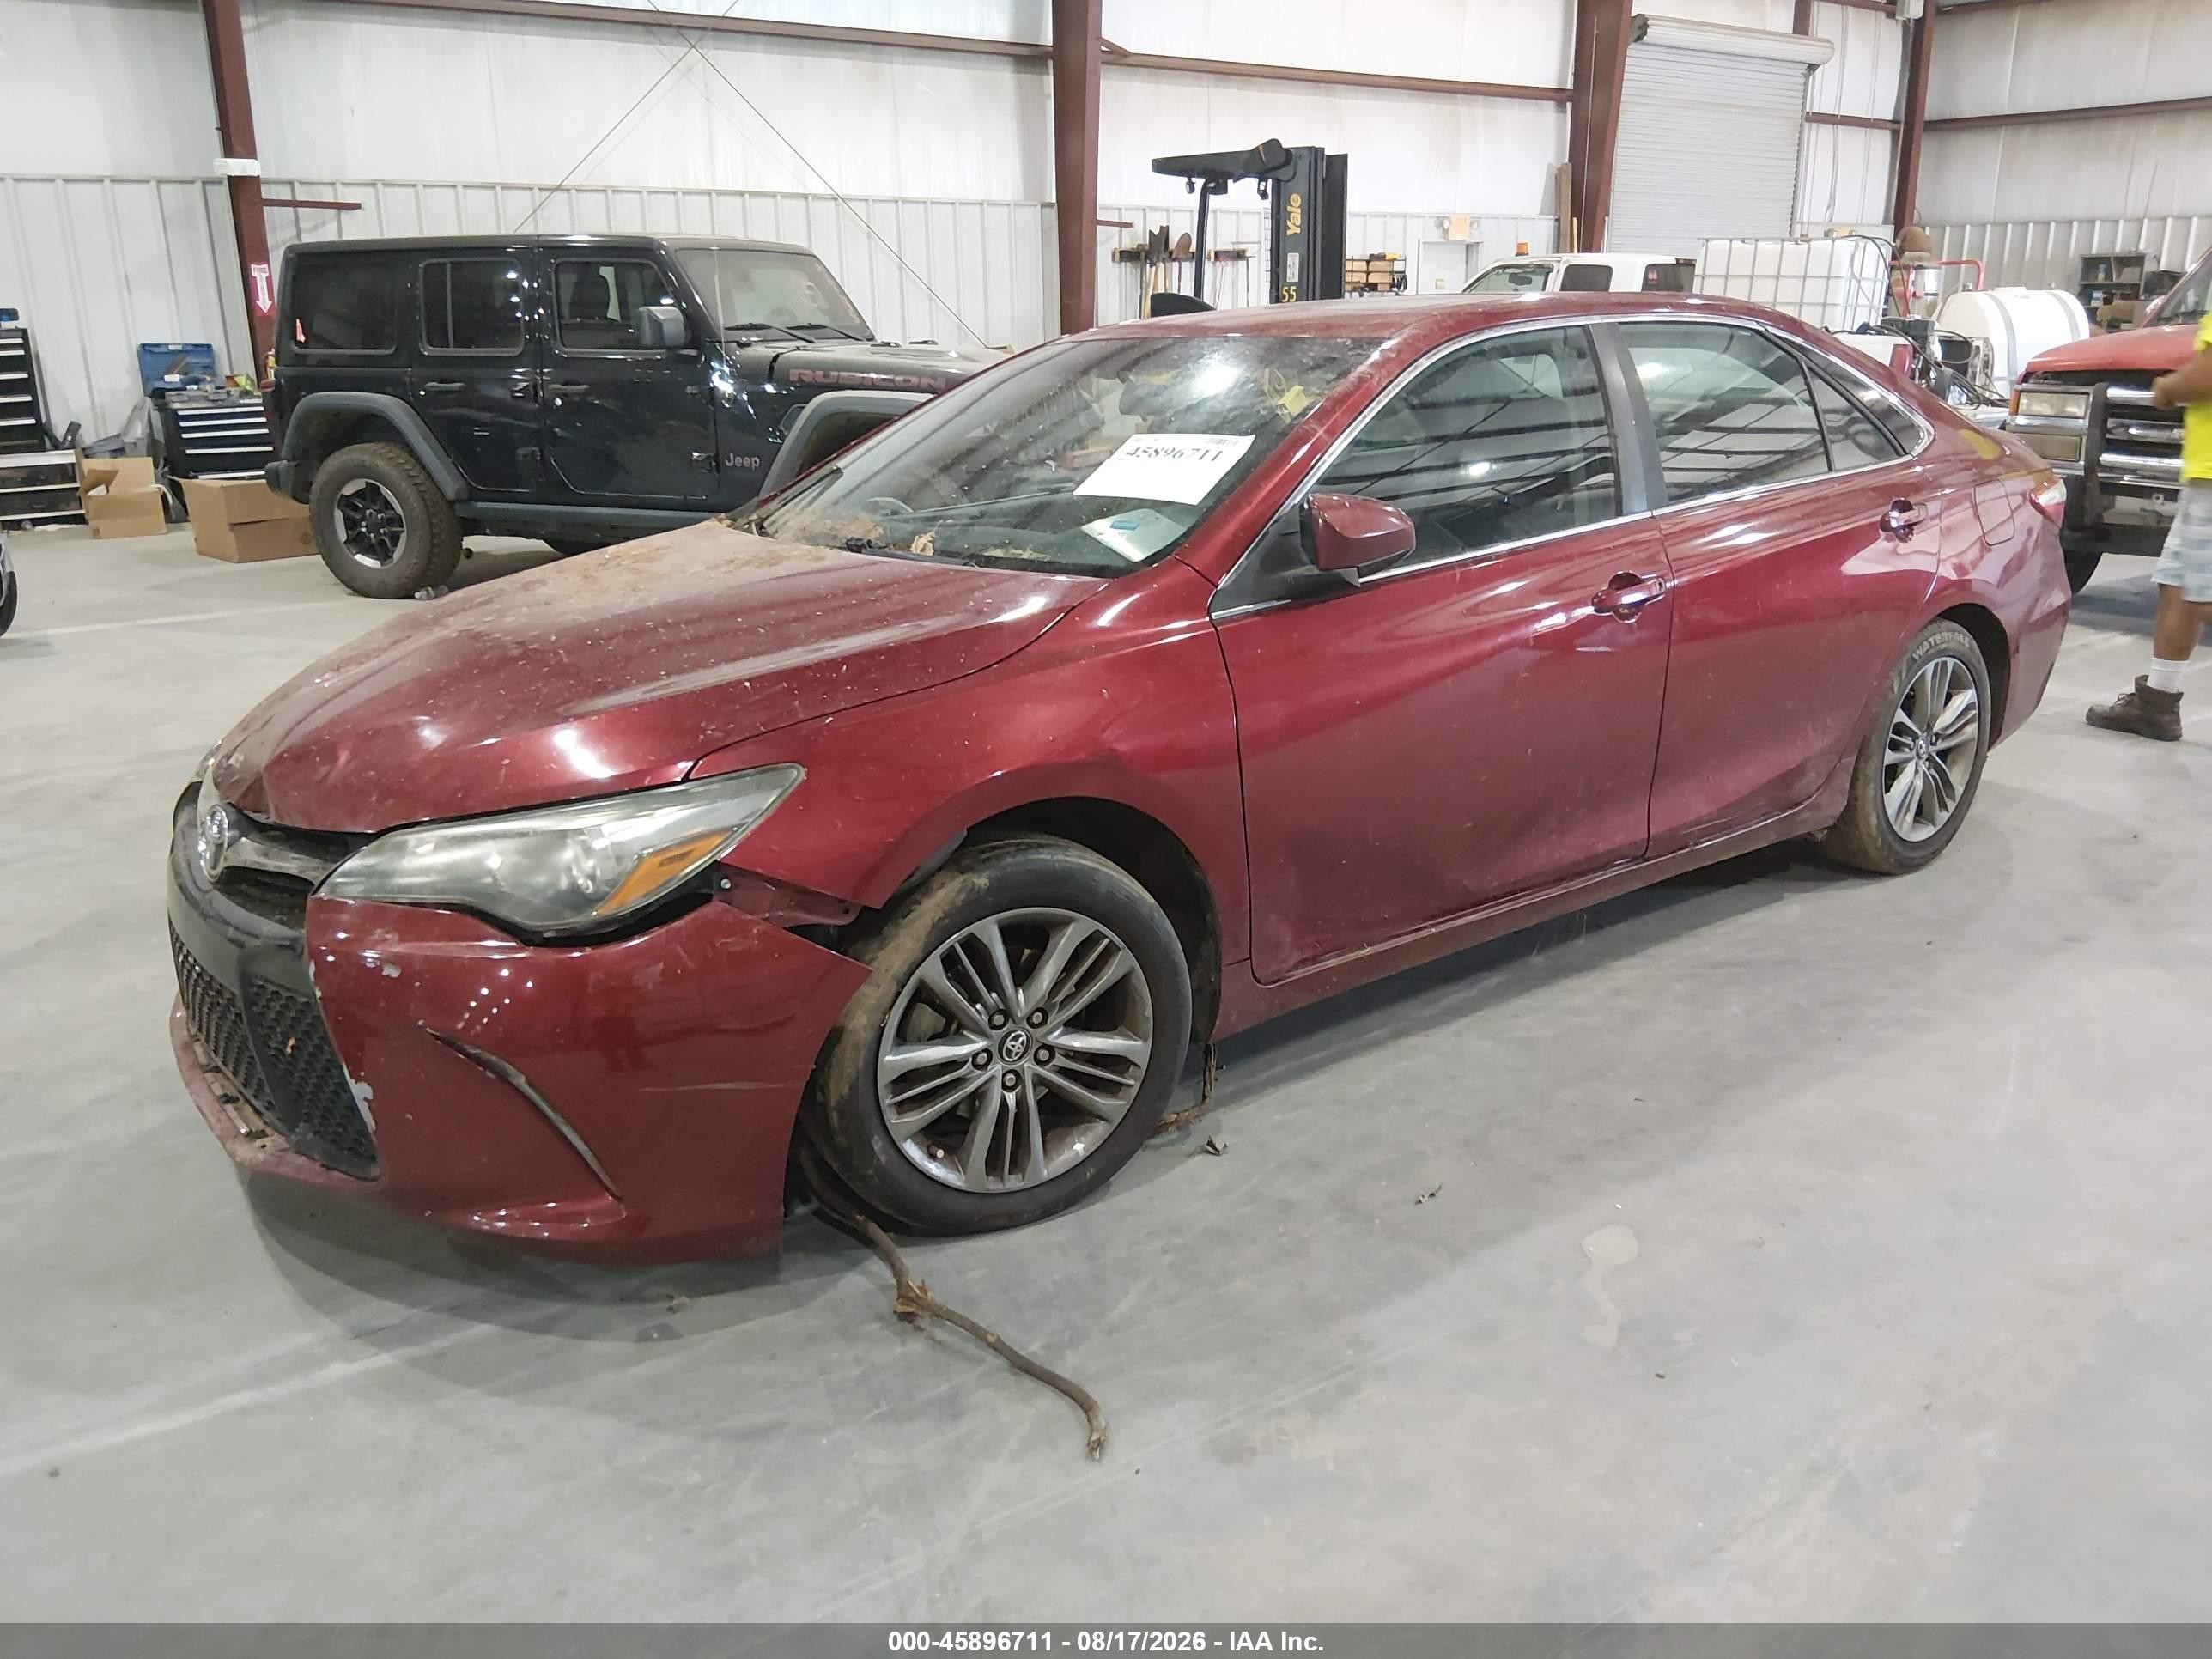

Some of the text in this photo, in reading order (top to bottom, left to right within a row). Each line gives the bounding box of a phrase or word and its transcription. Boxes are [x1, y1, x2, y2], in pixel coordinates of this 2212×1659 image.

[1287, 193, 1301, 235] Yale
[1282, 286, 1297, 302] 55
[789, 369, 945, 388] RUBICON
[725, 453, 760, 471] Jeep
[1127, 447, 1223, 461] 45896711
